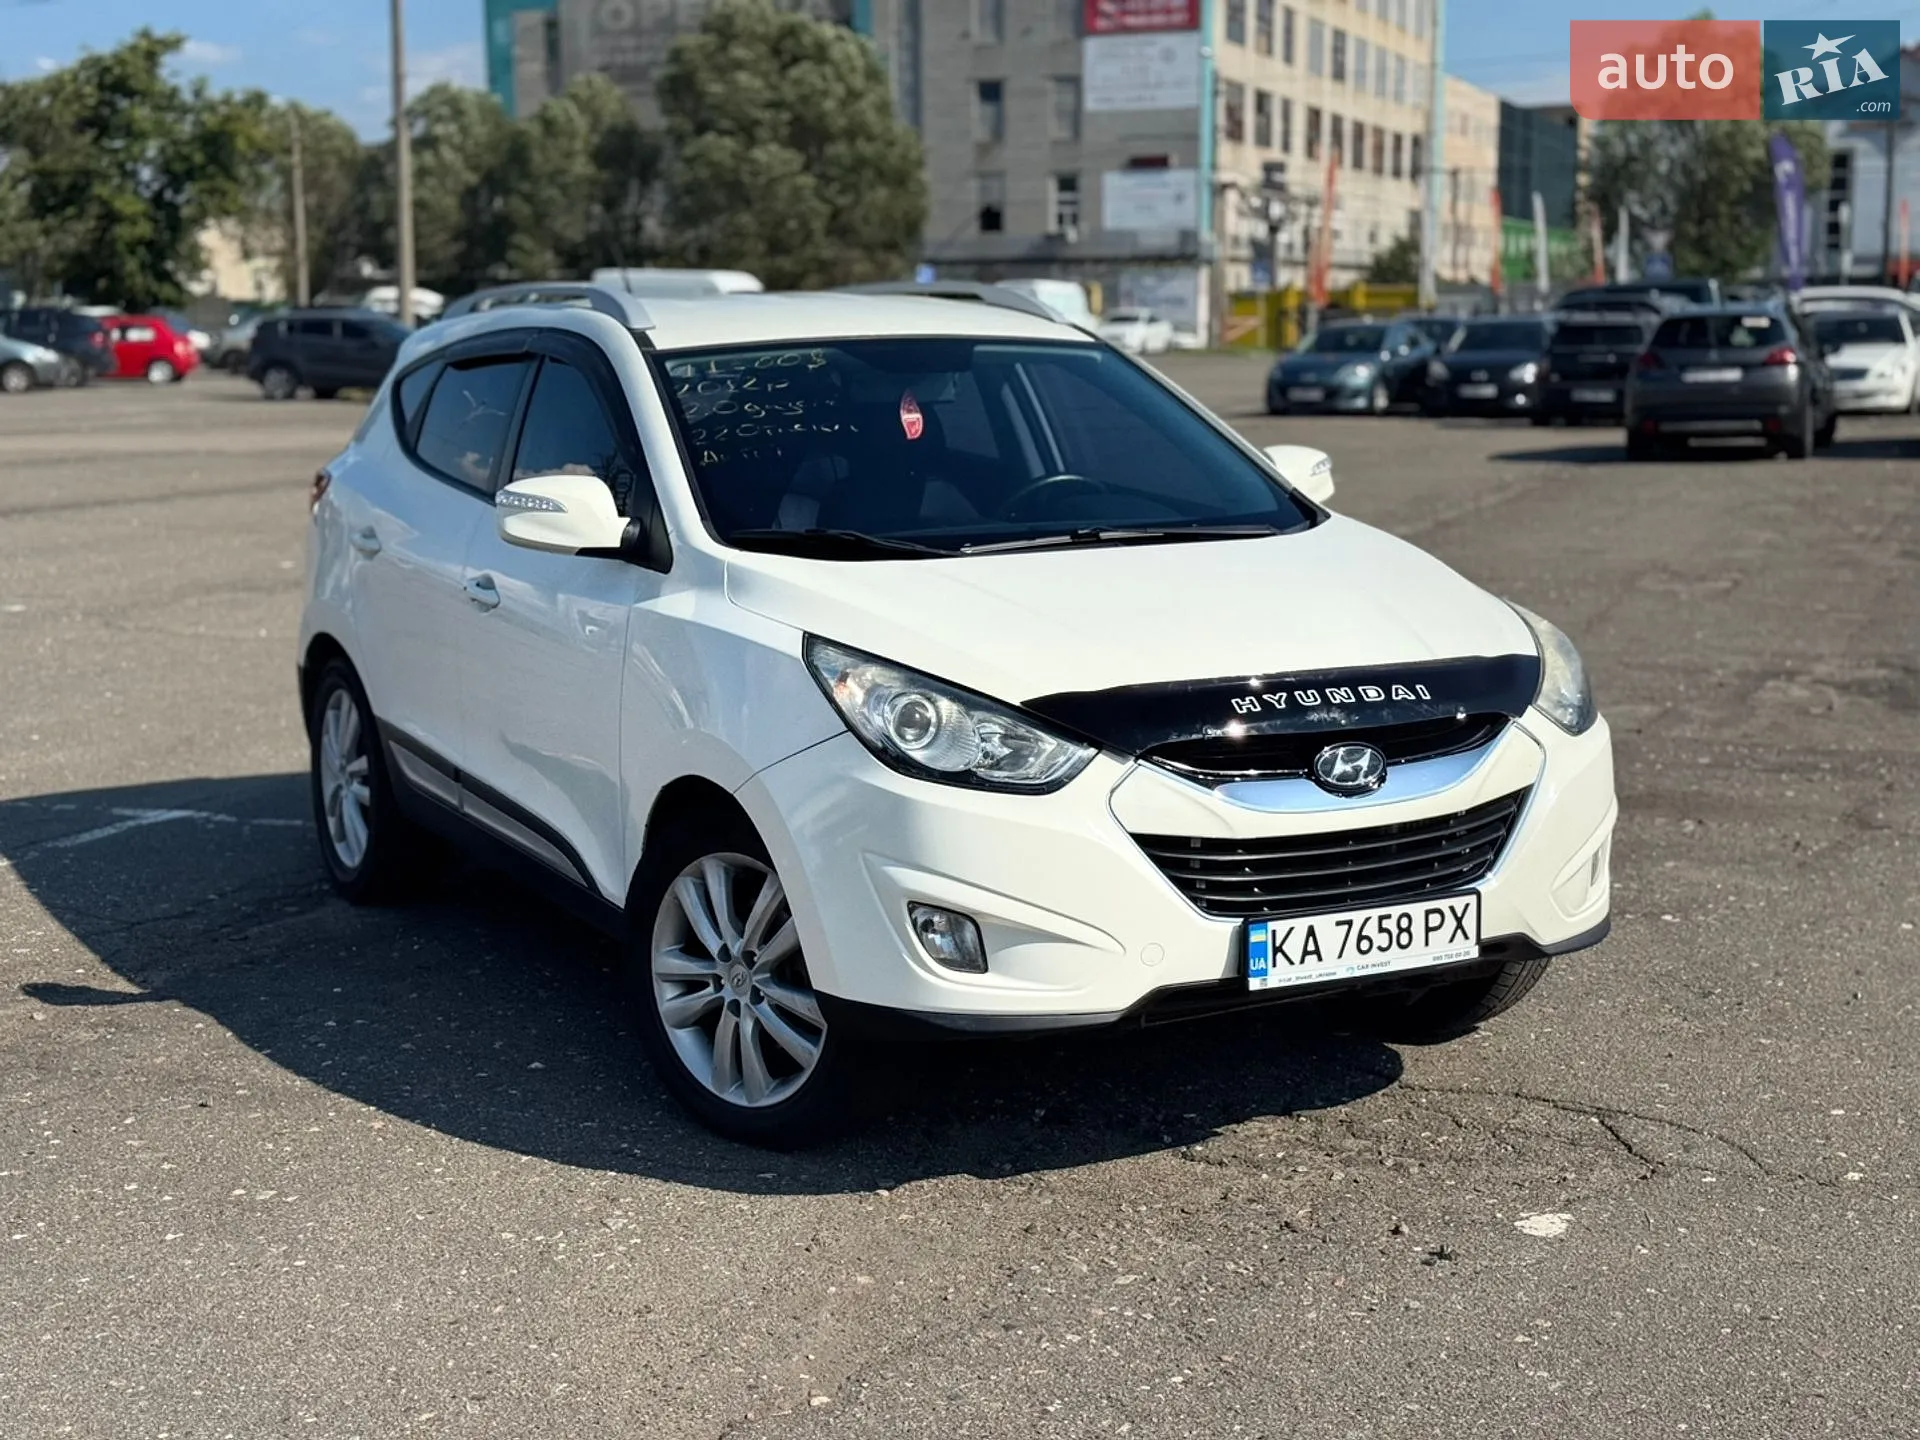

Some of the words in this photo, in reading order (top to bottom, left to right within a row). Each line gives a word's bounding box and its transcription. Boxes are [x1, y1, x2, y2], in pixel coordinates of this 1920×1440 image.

[1231, 684, 1431, 714] HYUNDAI
[1271, 925, 1323, 968] KA
[1335, 912, 1414, 960] 7658
[1424, 903, 1471, 947] PX
[1250, 957, 1266, 971] UA
